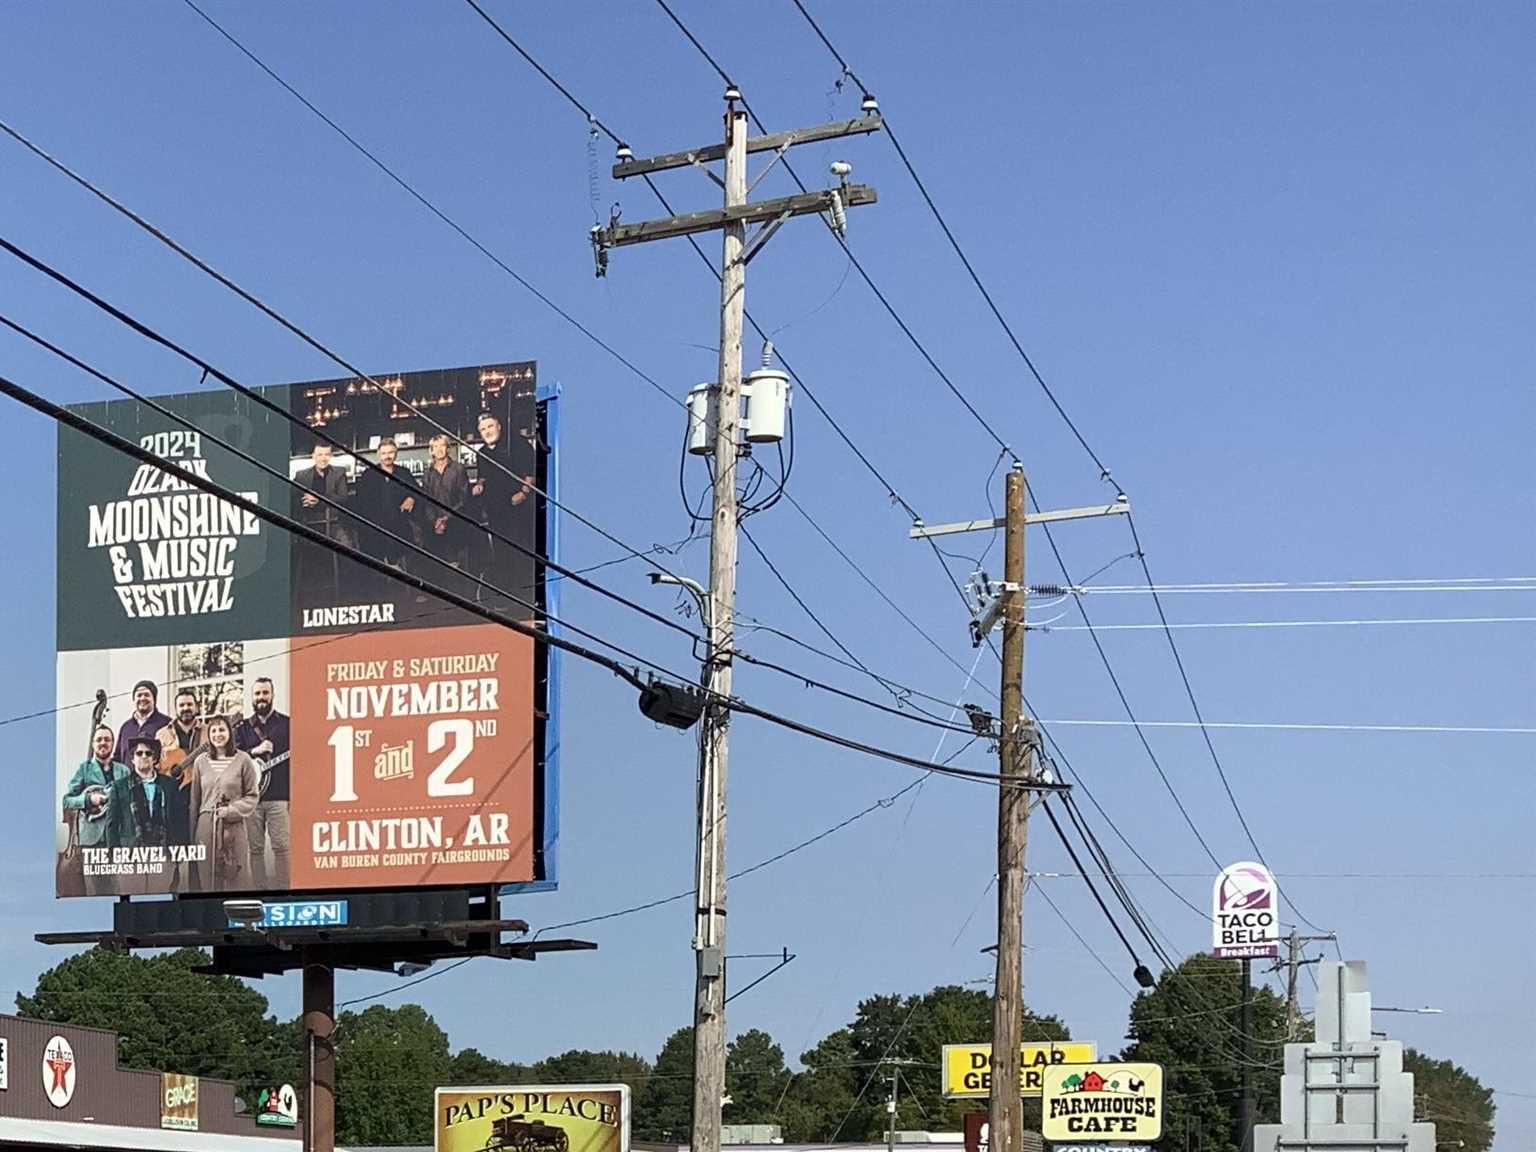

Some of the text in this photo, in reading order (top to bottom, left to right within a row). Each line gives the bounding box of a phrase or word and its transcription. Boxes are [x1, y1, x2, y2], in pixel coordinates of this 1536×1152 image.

[140, 431, 202, 458] 2024
[127, 459, 213, 496] OZARK
[88, 491, 260, 547] MOONSHINE
[109, 537, 238, 584] & MUSIC
[114, 577, 234, 618] FESTIVAL
[303, 603, 394, 628] LONESTAR
[327, 653, 500, 682] FRIDAY & SATURDAY
[326, 678, 500, 720] NOVEMBER
[375, 740, 414, 781] and
[313, 813, 511, 853] CLINTON, AR
[82, 845, 207, 864] THE GRAVEL YARD
[314, 849, 511, 869] VAN BUREN COUNTY FAIRGROUNDS
[84, 863, 163, 876] BLUEGRASS BAND
[263, 905, 336, 921] SION
[1217, 912, 1273, 928] TACO
[1222, 929, 1273, 944] BELL
[1221, 947, 1270, 957] Breakfast
[47, 1049, 73, 1061] TEXACO
[970, 1050, 1067, 1069] DLAR
[446, 1093, 618, 1127] PAP'S PLACE
[1050, 1097, 1156, 1119] FARMHOUSE
[1068, 1117, 1137, 1132] CAFE
